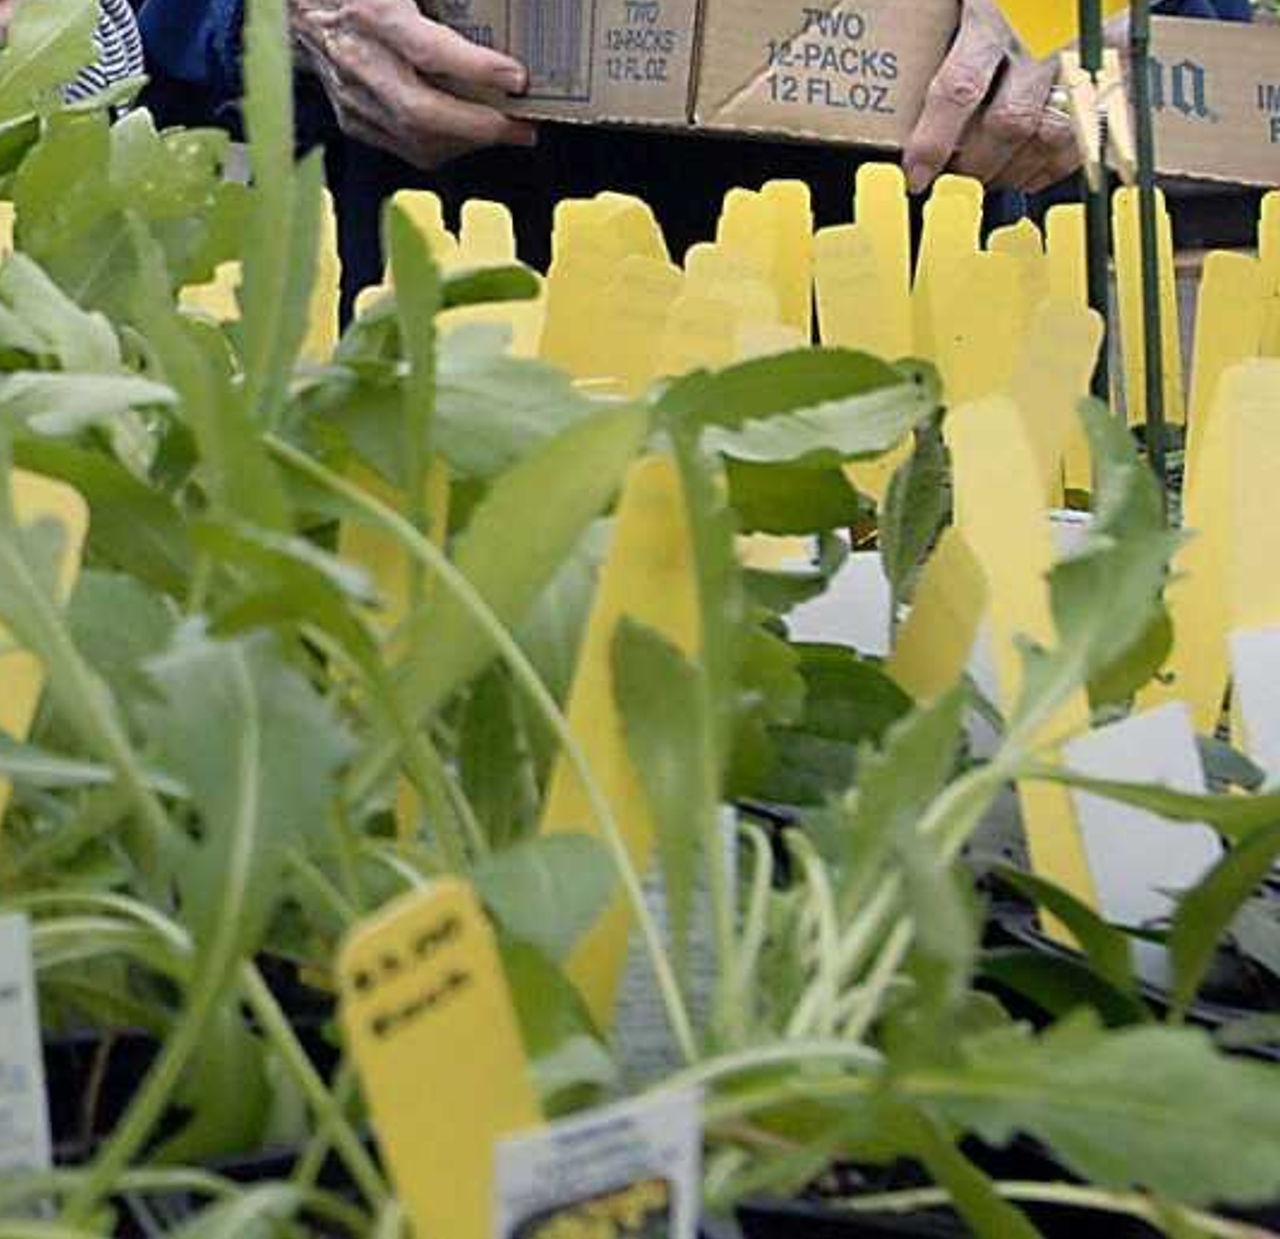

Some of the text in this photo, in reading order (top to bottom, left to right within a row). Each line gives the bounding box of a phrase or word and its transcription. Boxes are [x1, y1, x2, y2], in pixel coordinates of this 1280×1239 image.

[801, 7, 864, 41] TWO
[765, 39, 898, 80] 12-PACKS
[766, 73, 799, 102] 12
